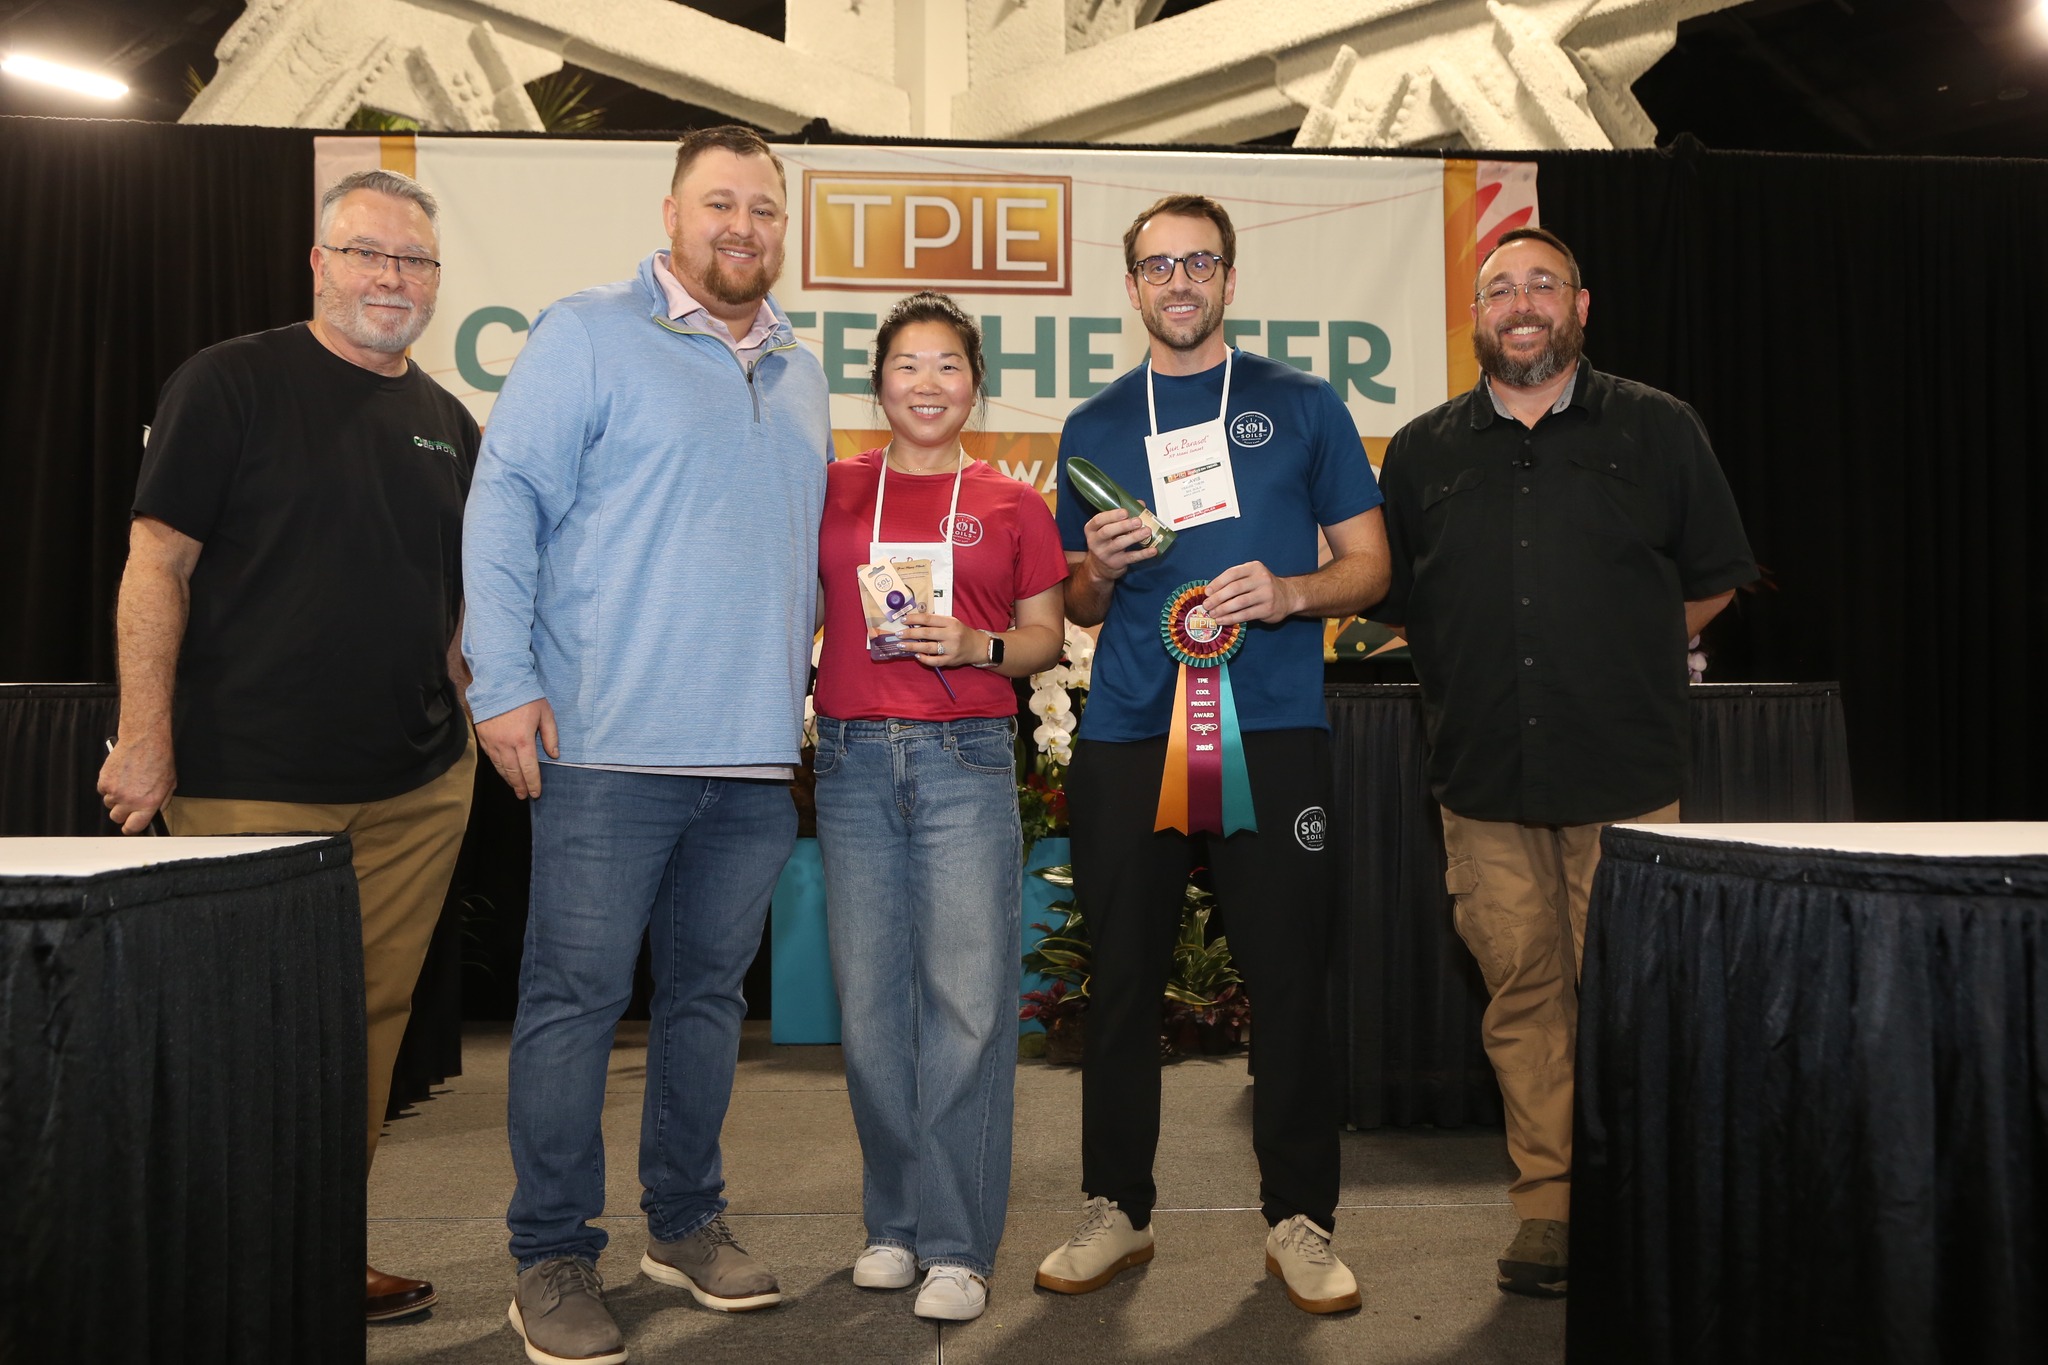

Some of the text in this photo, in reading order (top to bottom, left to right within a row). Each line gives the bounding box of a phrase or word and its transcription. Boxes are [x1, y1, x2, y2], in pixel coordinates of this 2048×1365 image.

[827, 194, 1048, 271] TPIE
[980, 314, 1397, 405] HEER
[1236, 422, 1268, 434] SOL
[1163, 435, 1208, 457] Sun Parasol
[954, 521, 977, 535] OL
[877, 577, 891, 588] SOL
[1195, 743, 1214, 751] 2026
